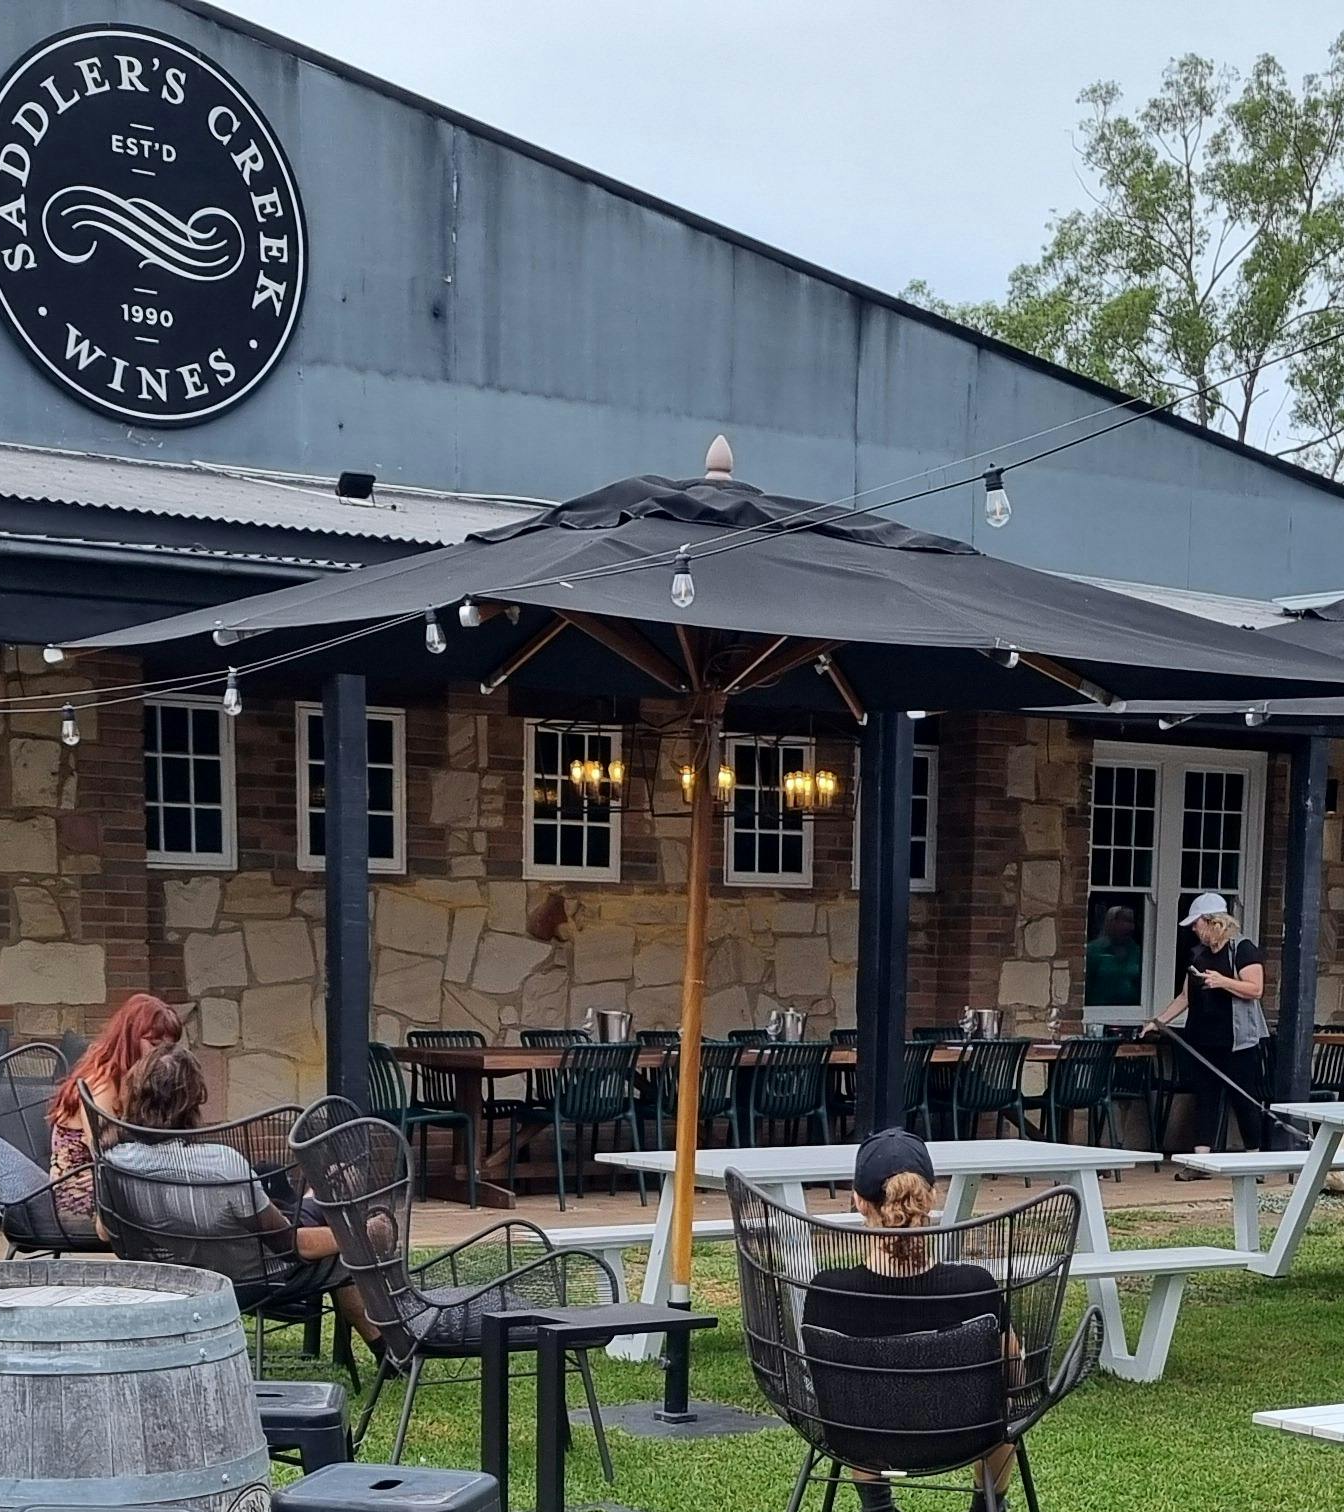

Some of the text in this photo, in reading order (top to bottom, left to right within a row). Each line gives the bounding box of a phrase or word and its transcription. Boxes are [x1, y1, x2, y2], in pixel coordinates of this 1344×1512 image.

[111, 134, 177, 163] EST'D
[207, 106, 289, 318] CREEK
[120, 303, 174, 328] 1990
[64, 322, 237, 403] WINES
